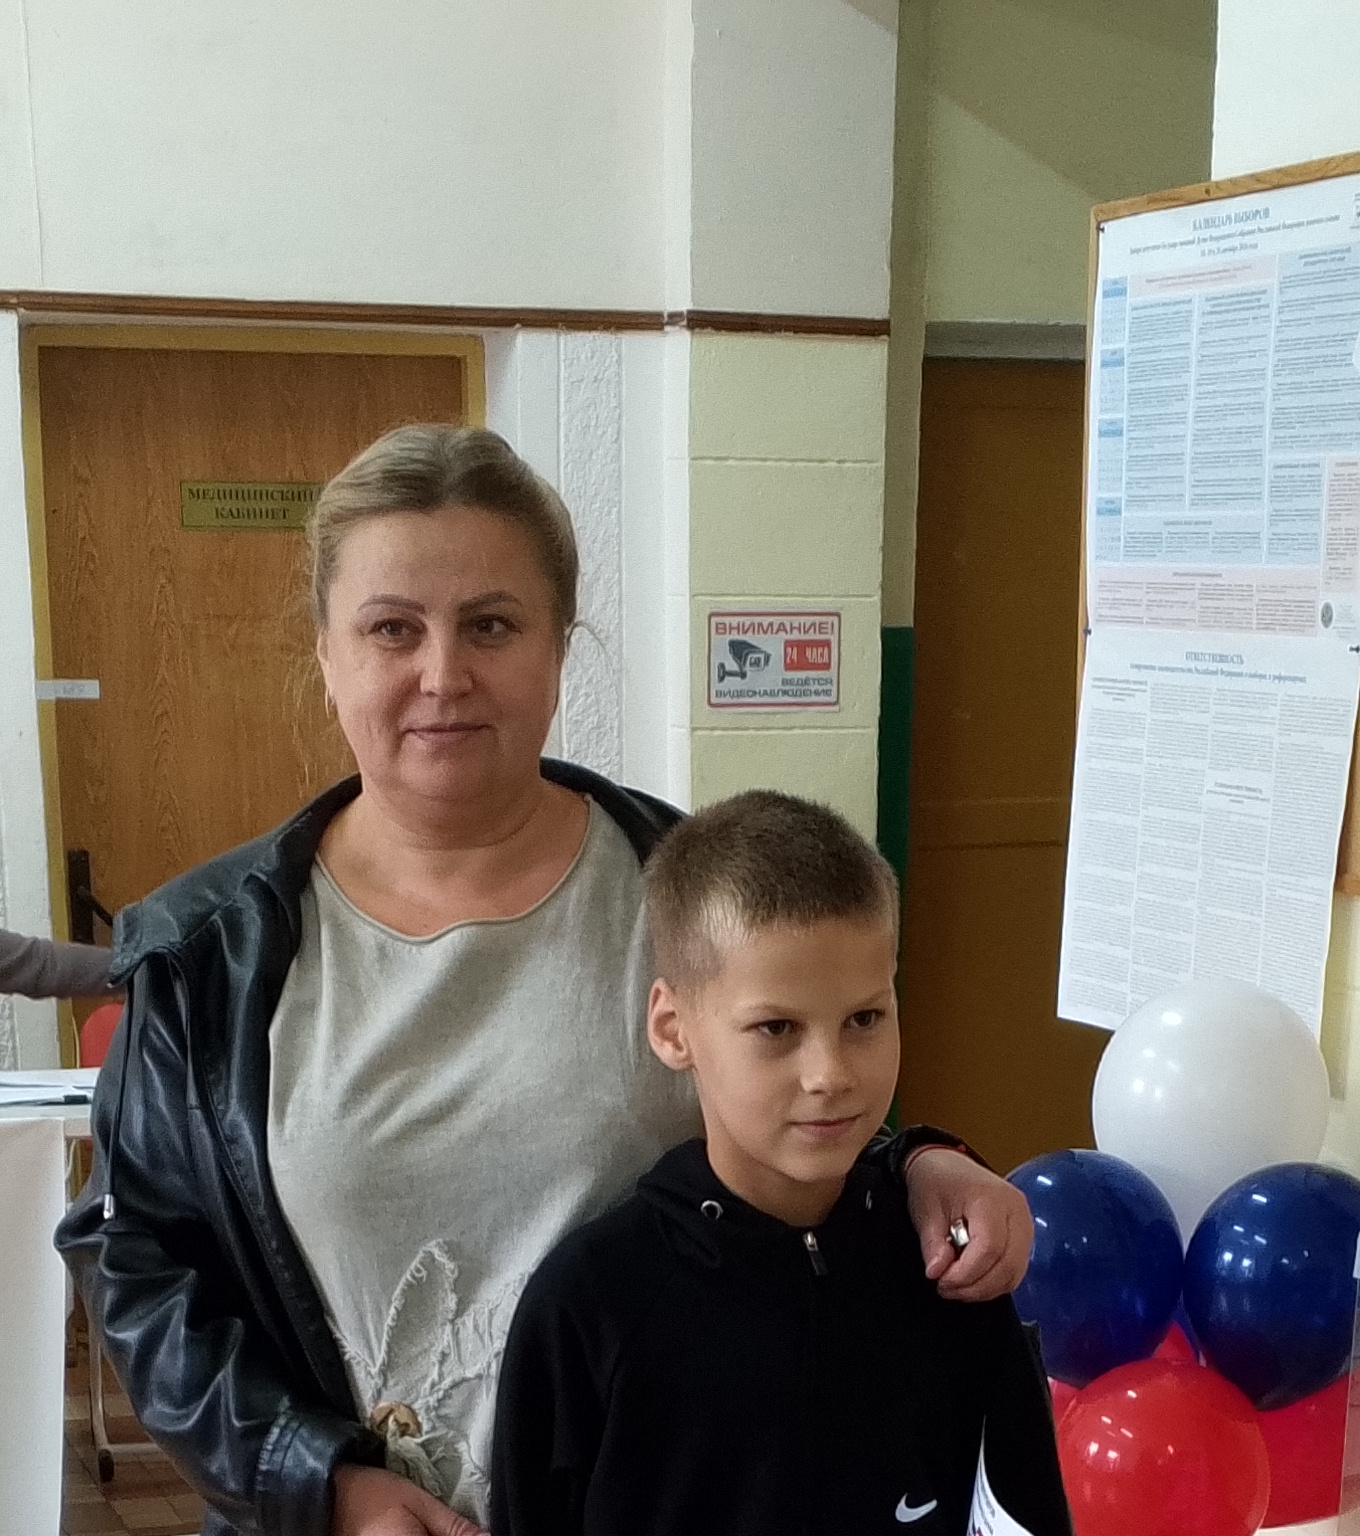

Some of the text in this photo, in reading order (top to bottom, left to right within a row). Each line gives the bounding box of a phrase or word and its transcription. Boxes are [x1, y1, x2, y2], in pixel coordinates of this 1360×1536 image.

[214, 507, 290, 520] КАБИНЕТ
[715, 622, 834, 635] ВНИМАНИЕ!
[786, 646, 829, 663] 24 ЧАСА
[715, 688, 832, 699] ВИДЕОНАБЛЮДЕНИЕ
